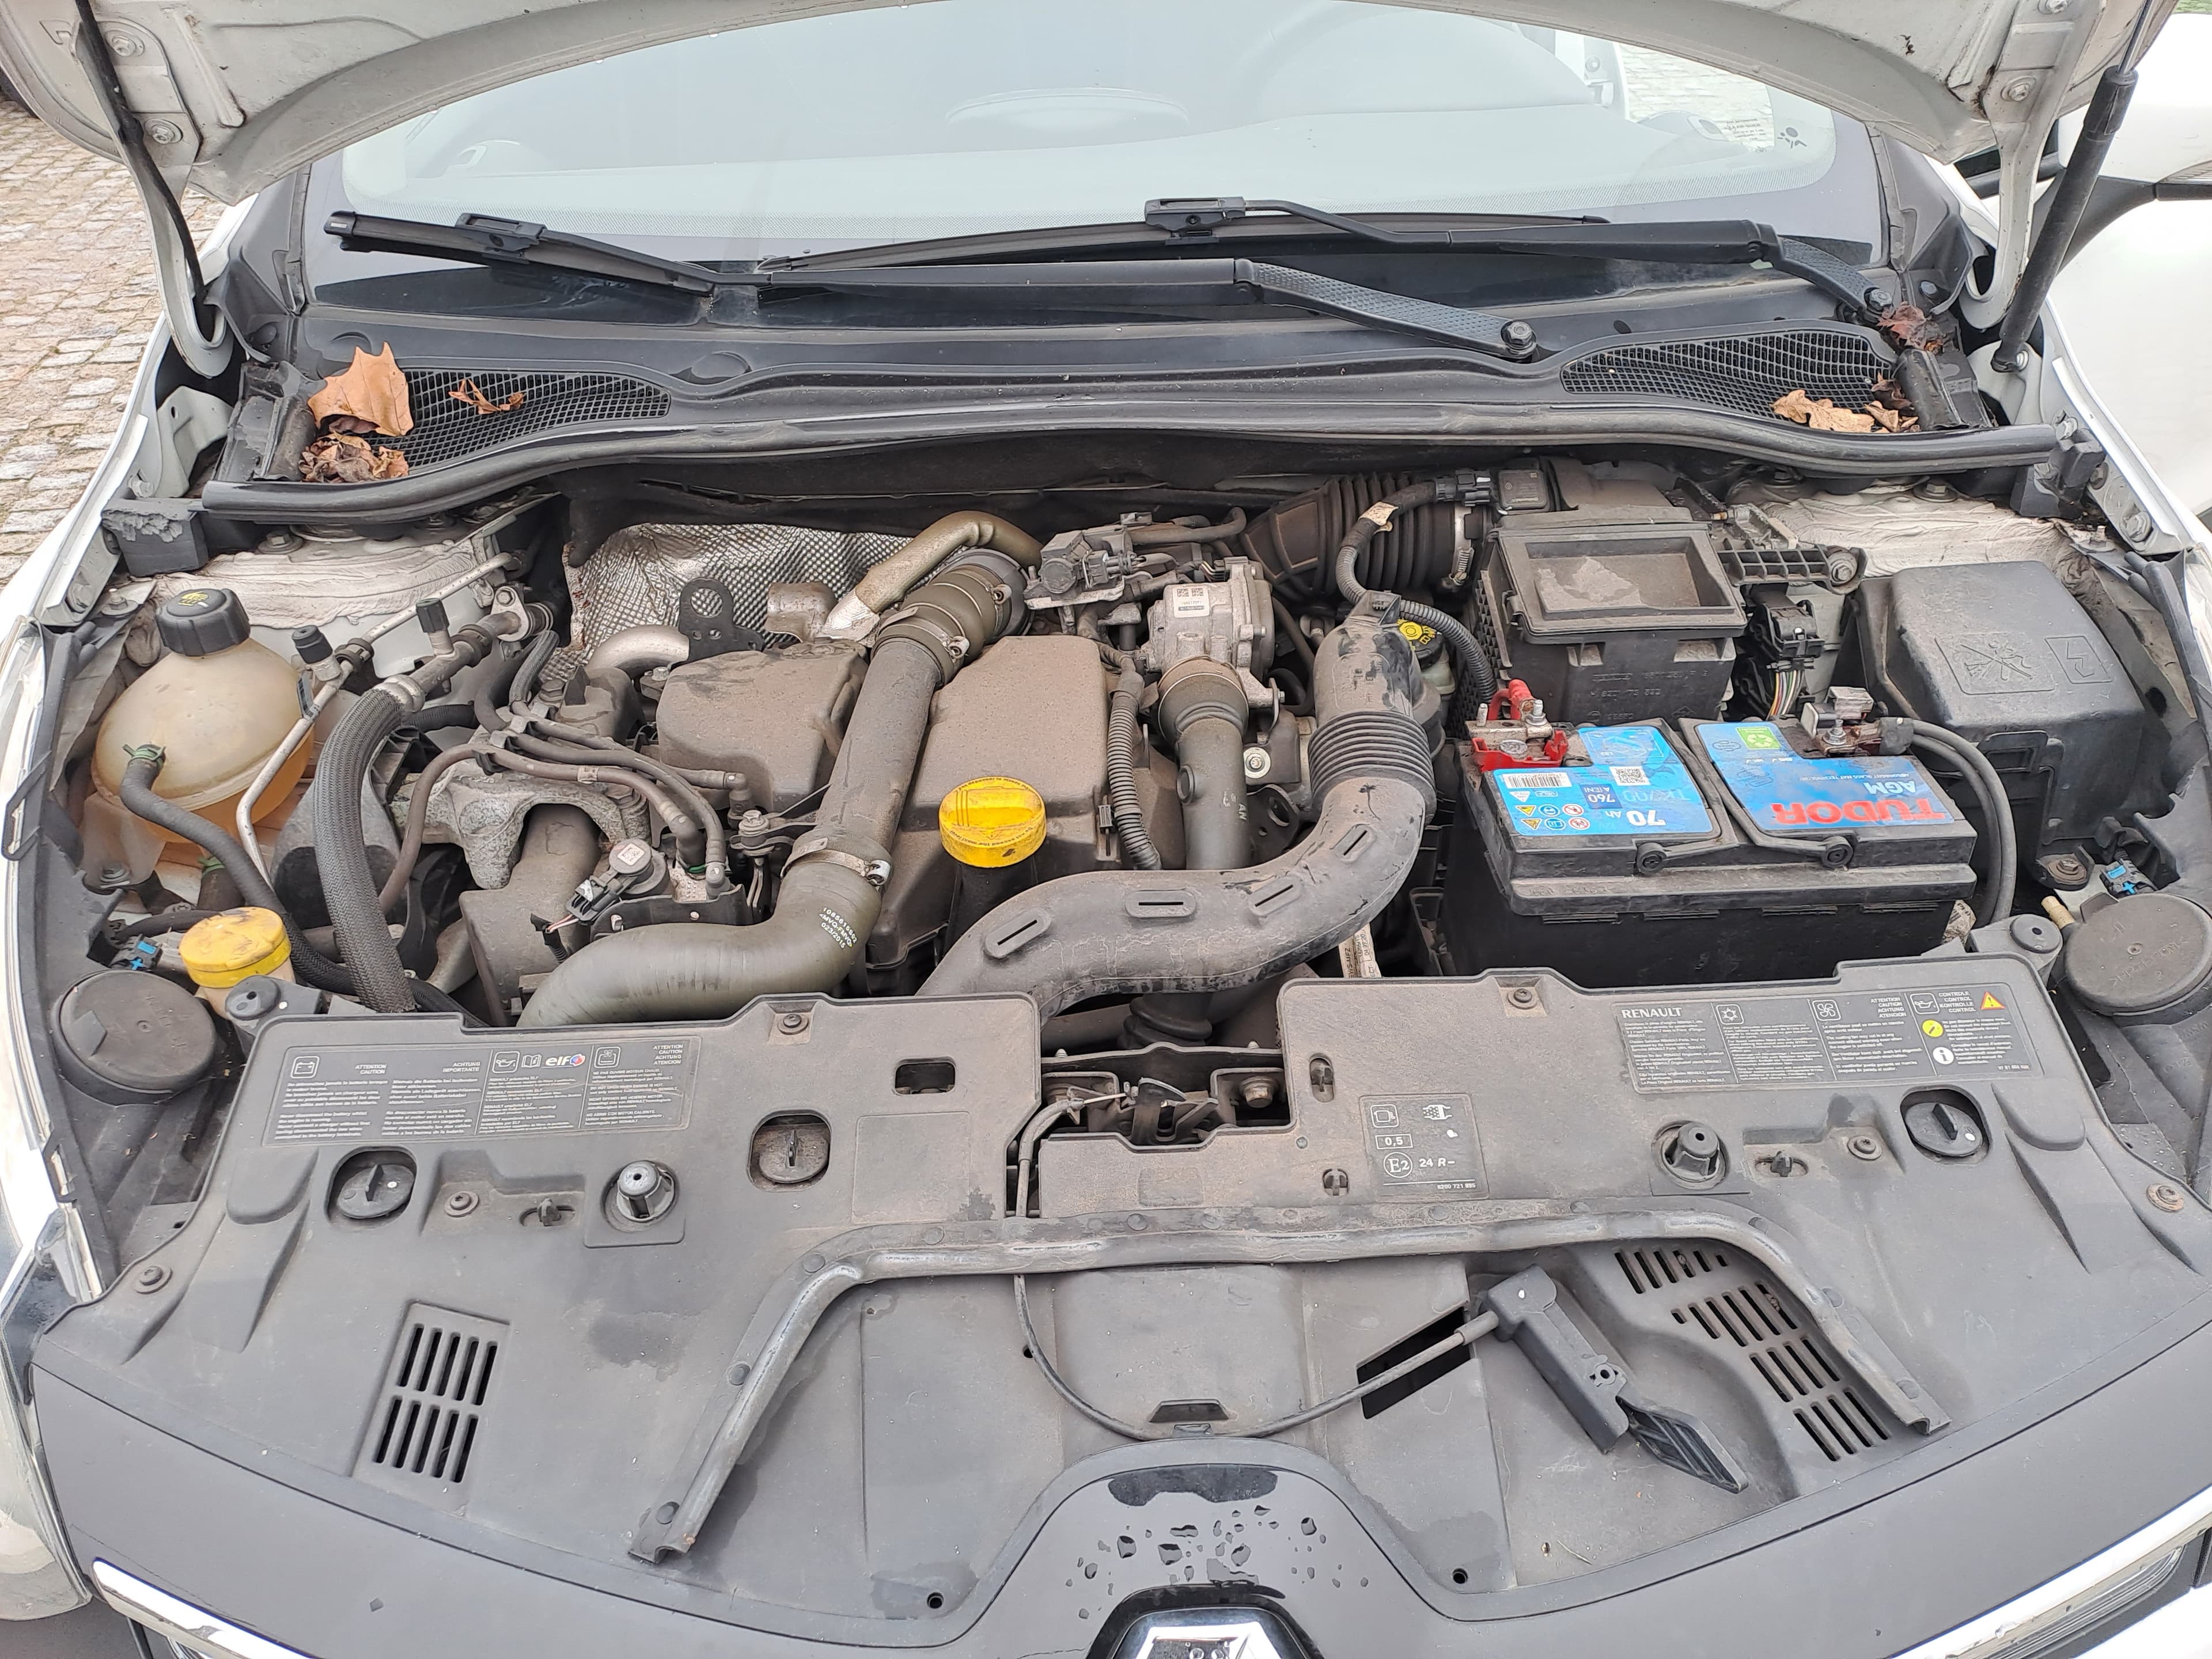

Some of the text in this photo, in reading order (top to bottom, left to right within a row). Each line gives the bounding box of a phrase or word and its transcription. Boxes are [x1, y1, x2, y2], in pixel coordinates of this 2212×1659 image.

[1863, 781, 1916, 795] AGM
[1588, 793, 1615, 803] 760
[1605, 809, 1666, 826] 70 Ah
[1771, 798, 1946, 825] TUDOR
[821, 922, 846, 949] 023/2015
[1622, 1007, 1681, 1018] RENAULT
[1385, 1138, 1403, 1147] 0,5
[1388, 1158, 1410, 1173] E2
[1419, 1158, 1434, 1167] 24
